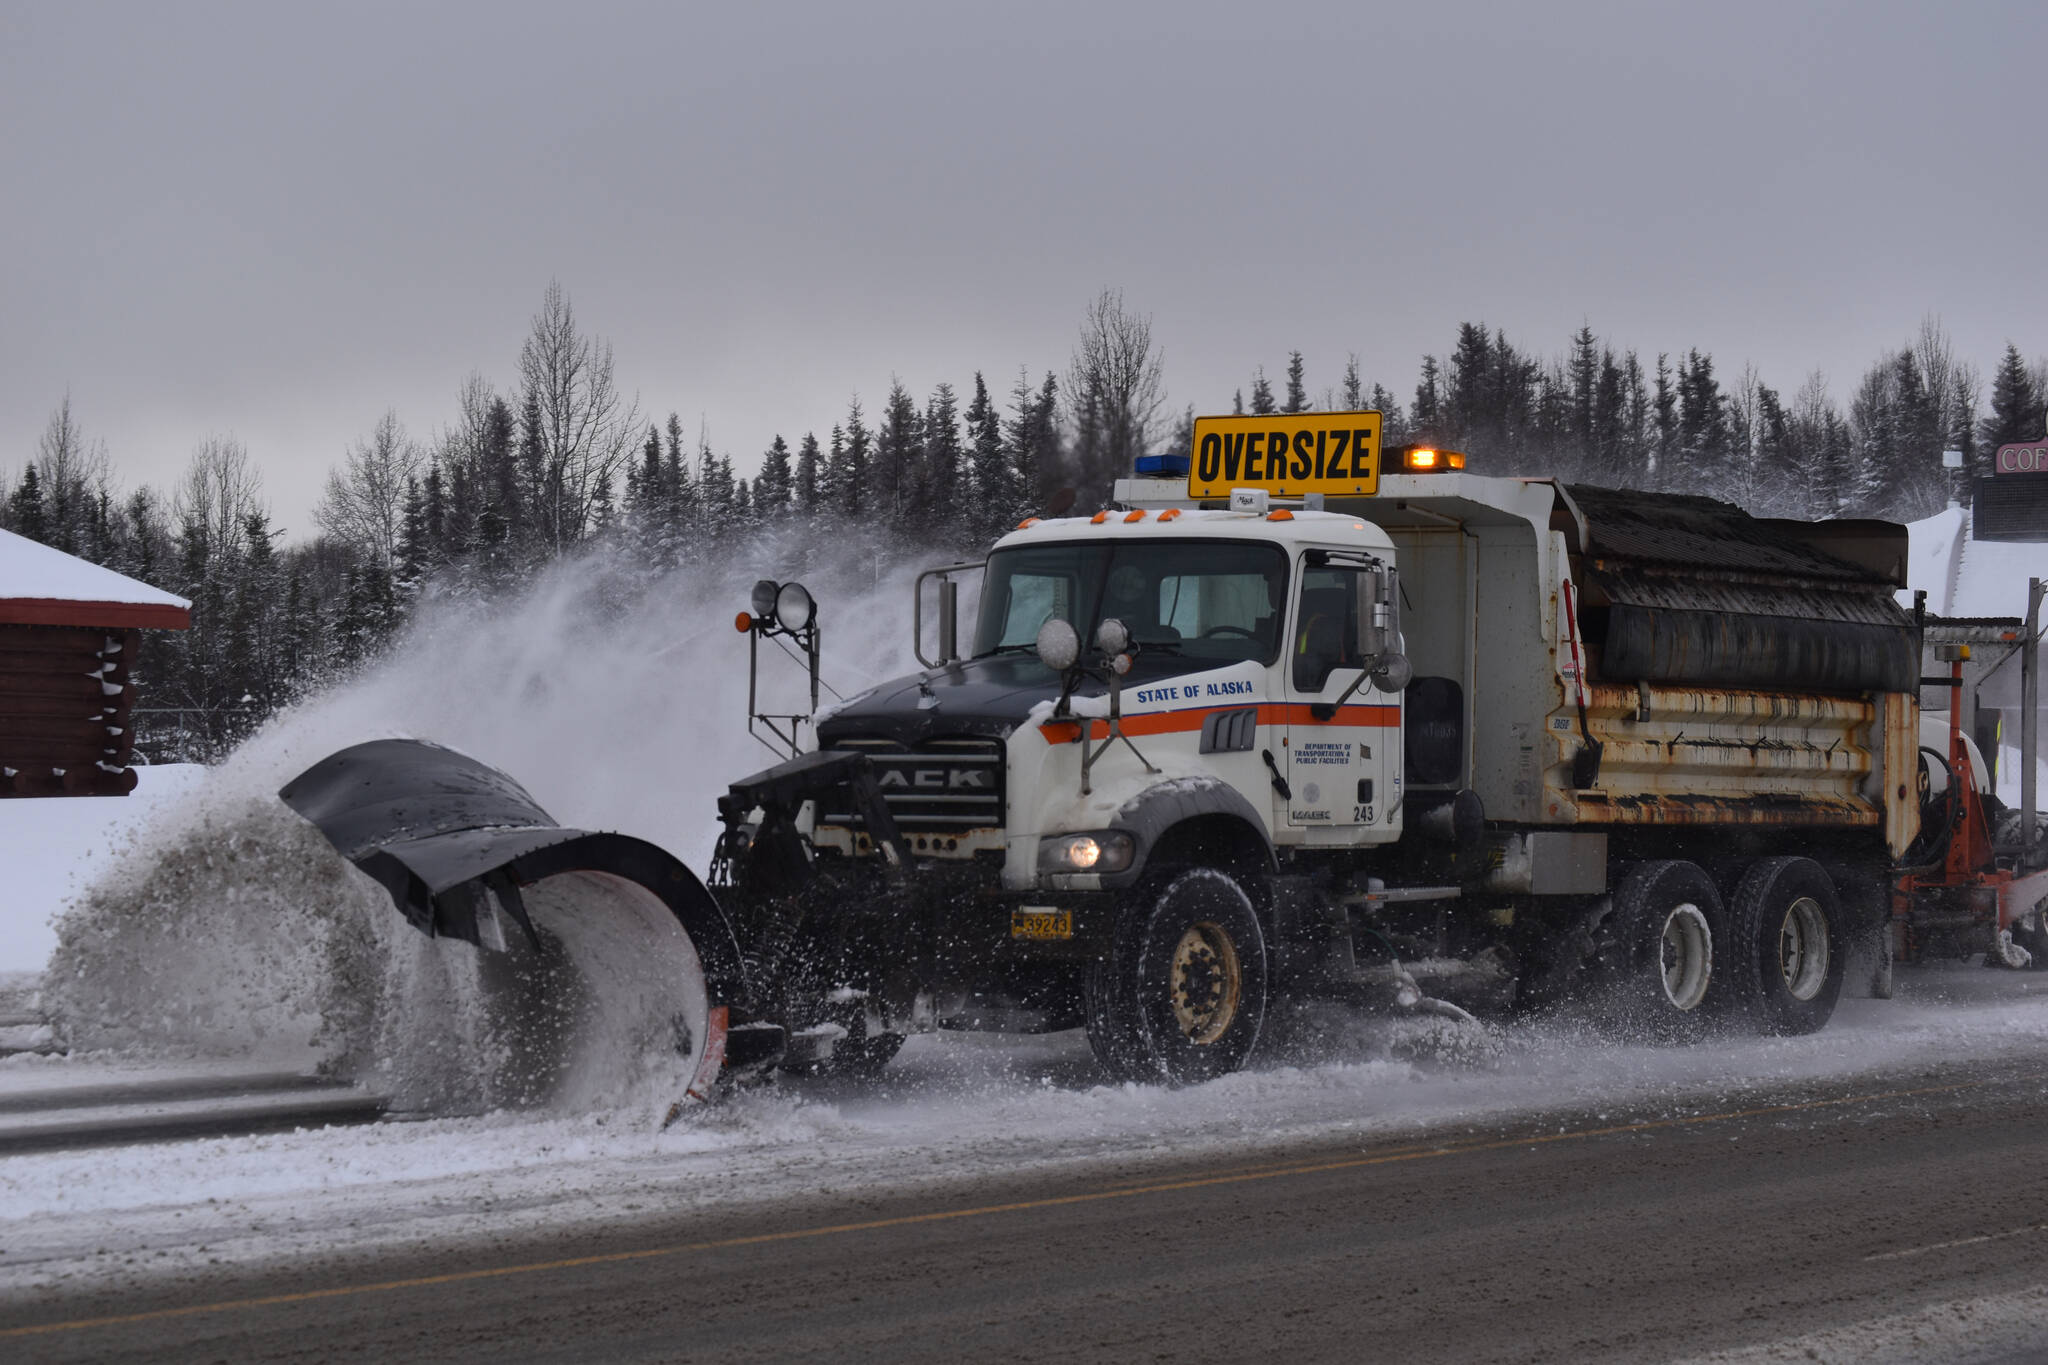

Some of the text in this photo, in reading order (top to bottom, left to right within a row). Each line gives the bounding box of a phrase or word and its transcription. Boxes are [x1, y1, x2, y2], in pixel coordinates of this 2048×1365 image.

[1198, 429, 1372, 482] OVERSIZE
[2001, 447, 2048, 471] COF
[1137, 681, 1253, 703] STATE OF ALASKA
[878, 769, 984, 787] ACK
[1353, 806, 1374, 822] 243
[1025, 918, 1068, 932] 39243
